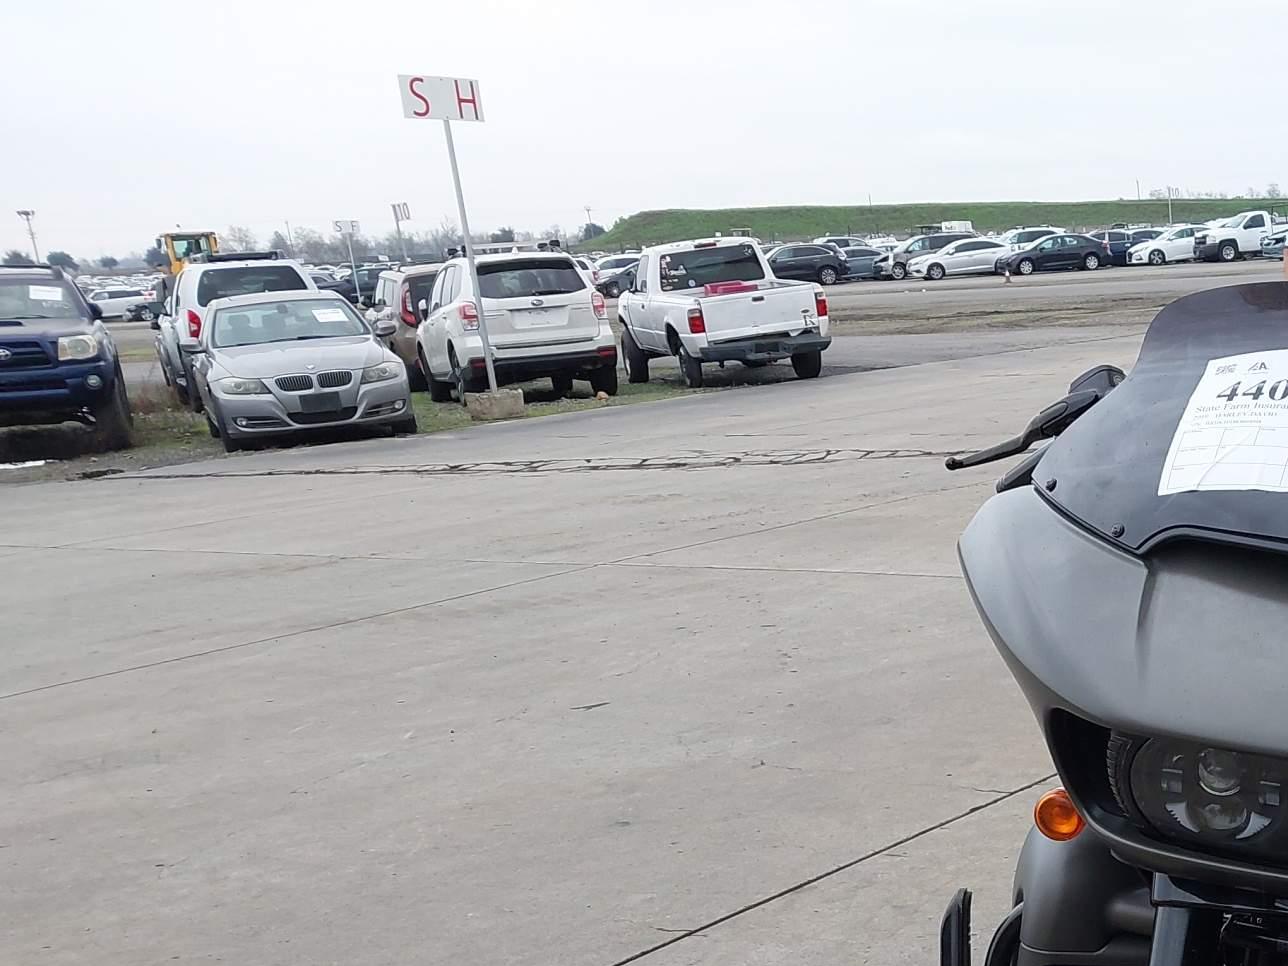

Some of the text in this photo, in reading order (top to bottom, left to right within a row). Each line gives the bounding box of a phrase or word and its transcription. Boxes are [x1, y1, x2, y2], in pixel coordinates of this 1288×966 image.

[408, 77, 479, 120] S H
[335, 220, 343, 232] S
[1194, 404, 1221, 414] State
[1223, 402, 1250, 411] Farm
